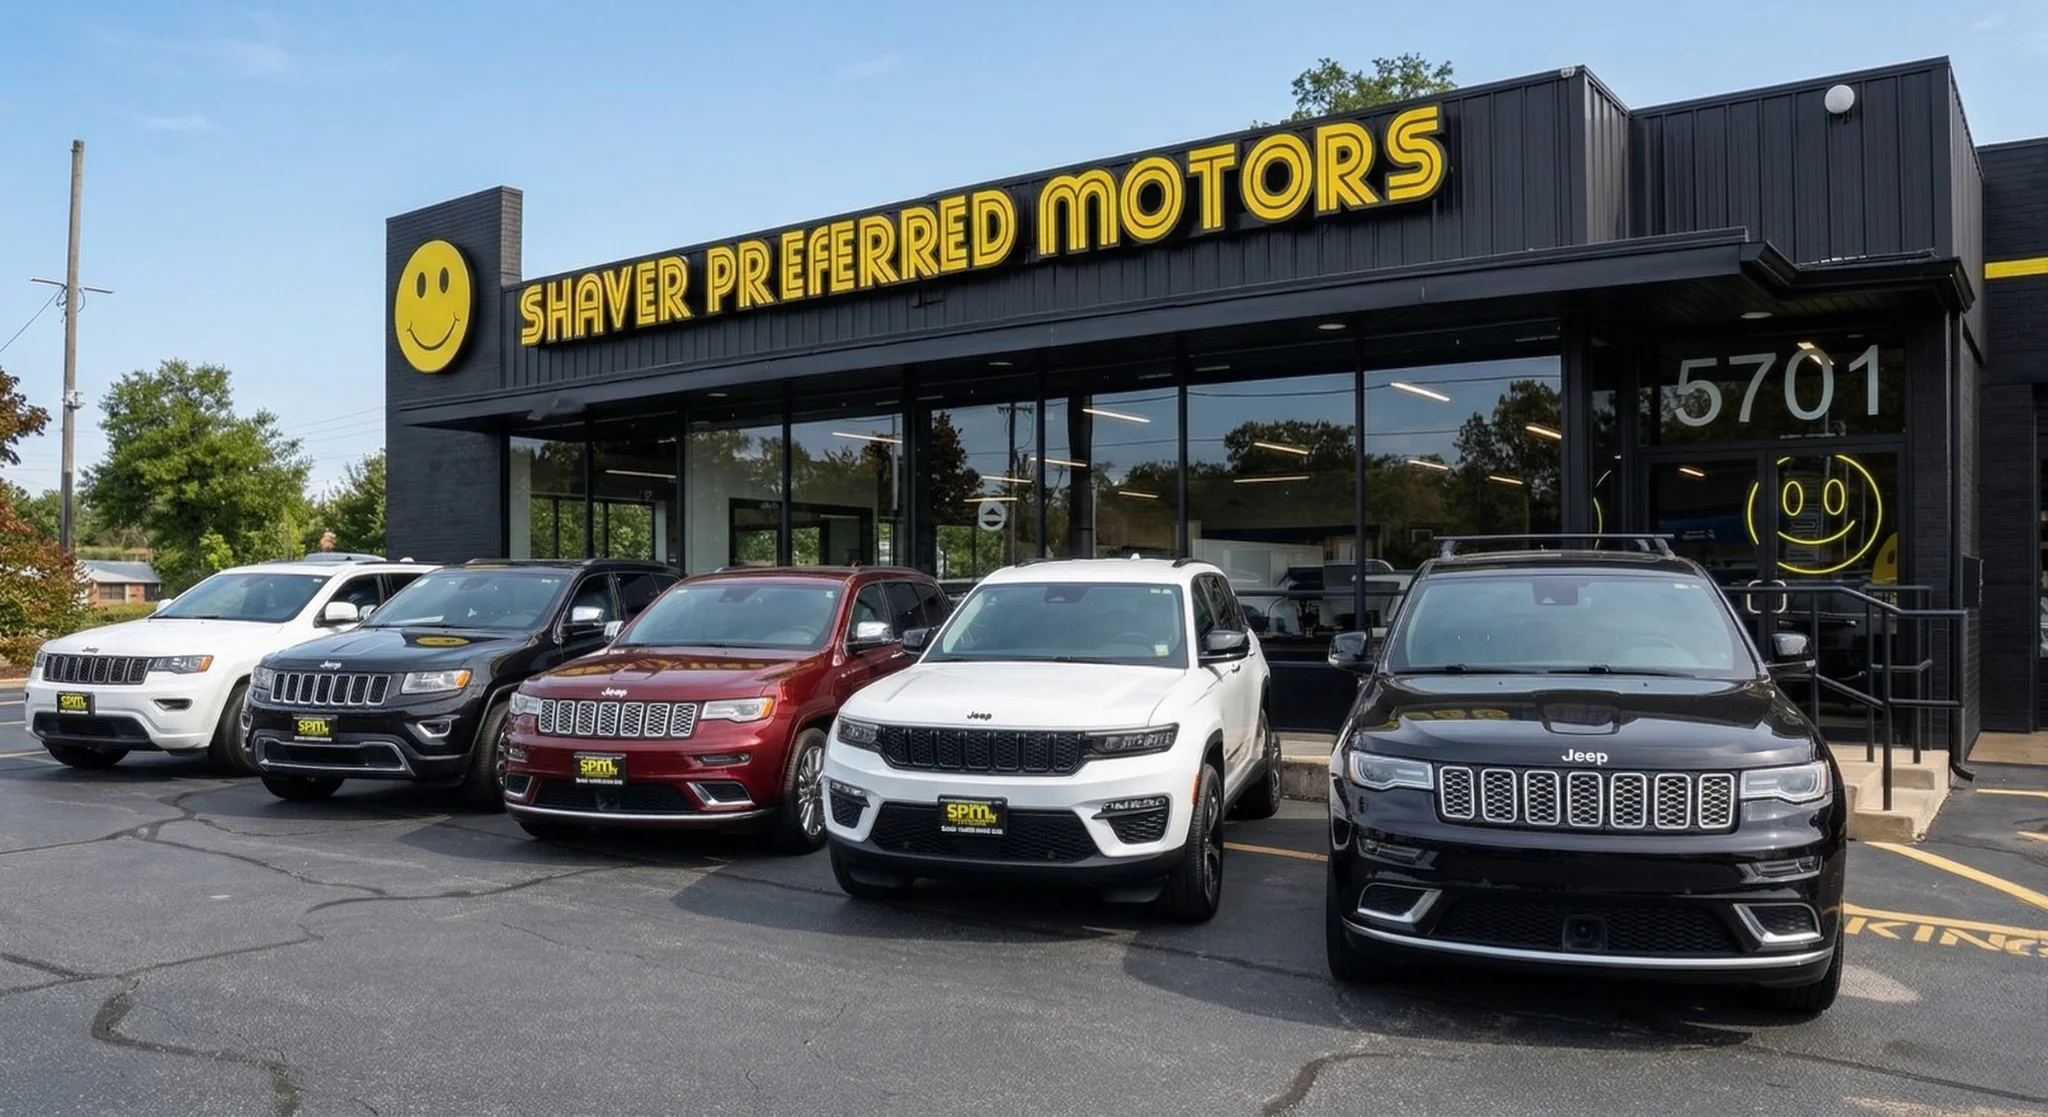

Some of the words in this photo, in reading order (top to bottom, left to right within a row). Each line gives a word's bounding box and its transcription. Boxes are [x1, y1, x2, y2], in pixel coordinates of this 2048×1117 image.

[520, 255, 693, 347] SHAVER
[705, 188, 1018, 312] PREFERRED
[1037, 104, 1447, 258] MOTORS
[1674, 344, 1880, 428] 5701
[601, 687, 627, 697] Jeep
[967, 710, 992, 721] Jeep
[1561, 749, 1608, 765] Jeep
[947, 804, 989, 819] SPM
